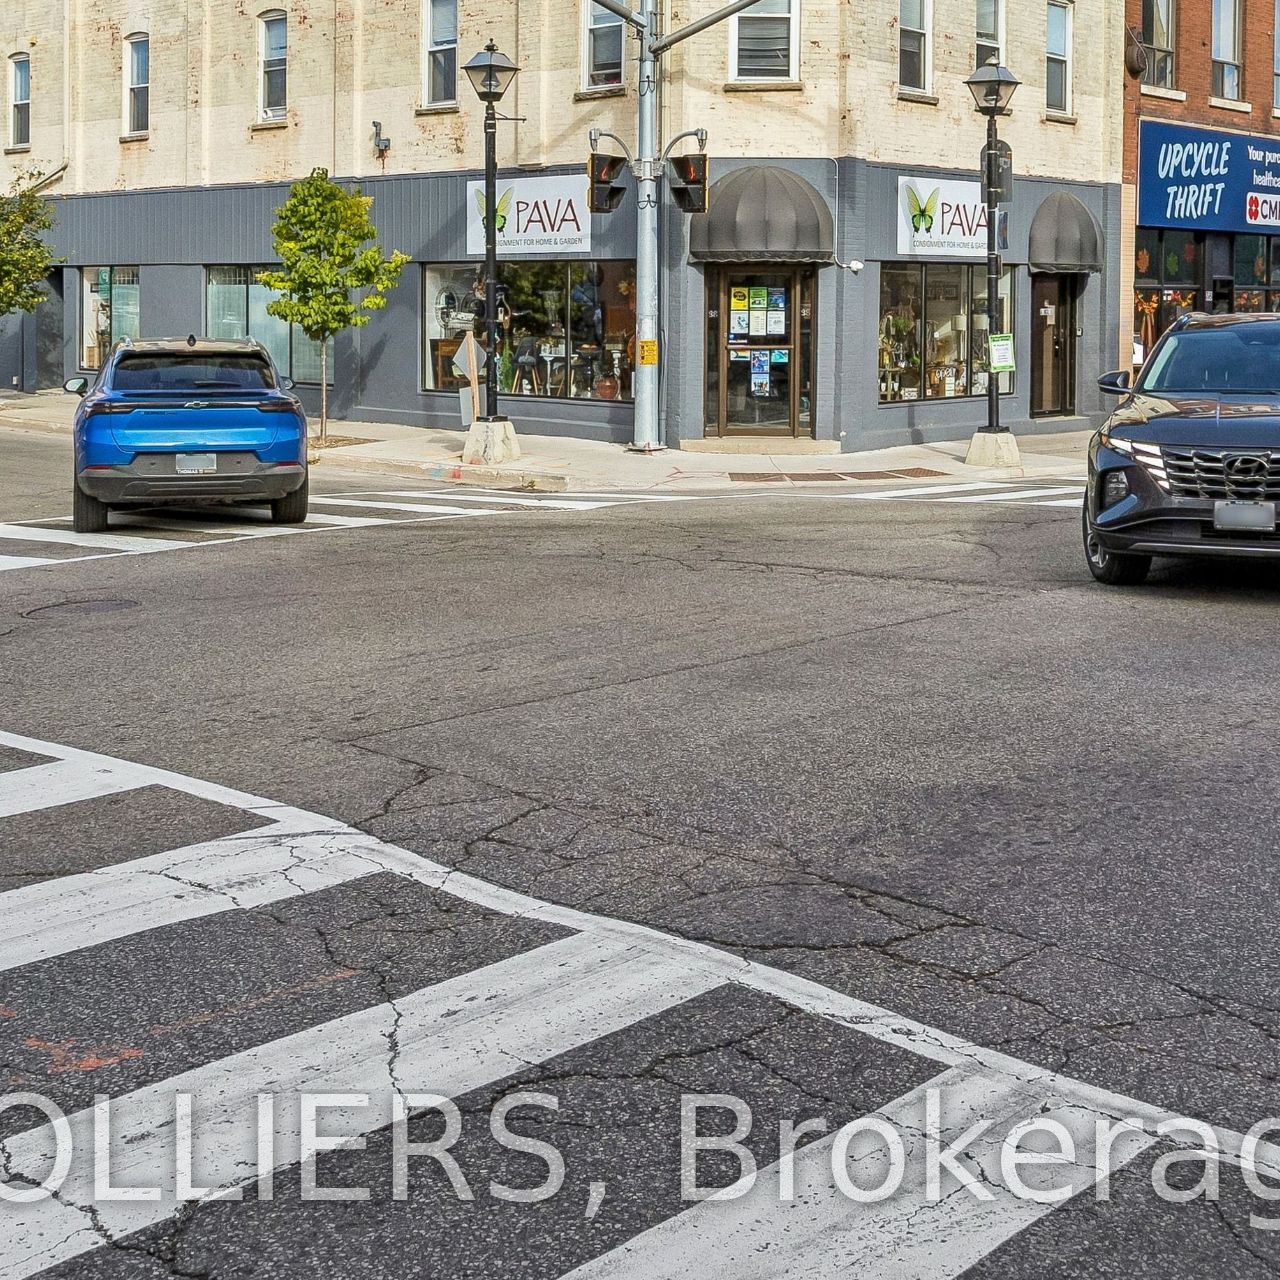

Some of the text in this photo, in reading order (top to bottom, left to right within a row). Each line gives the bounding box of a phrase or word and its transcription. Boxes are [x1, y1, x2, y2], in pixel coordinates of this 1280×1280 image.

[1158, 141, 1232, 179] UPCYCLE
[1247, 145, 1264, 161] Your
[516, 198, 581, 234] PAVA
[1166, 183, 1226, 220] THRIFT
[941, 202, 988, 236] PAVA
[536, 238, 553, 246] HOME
[560, 237, 583, 245] GARDEN
[913, 240, 946, 248] CONSIGNMENT
[947, 241, 956, 249] FOR
[956, 241, 971, 249] HOME
